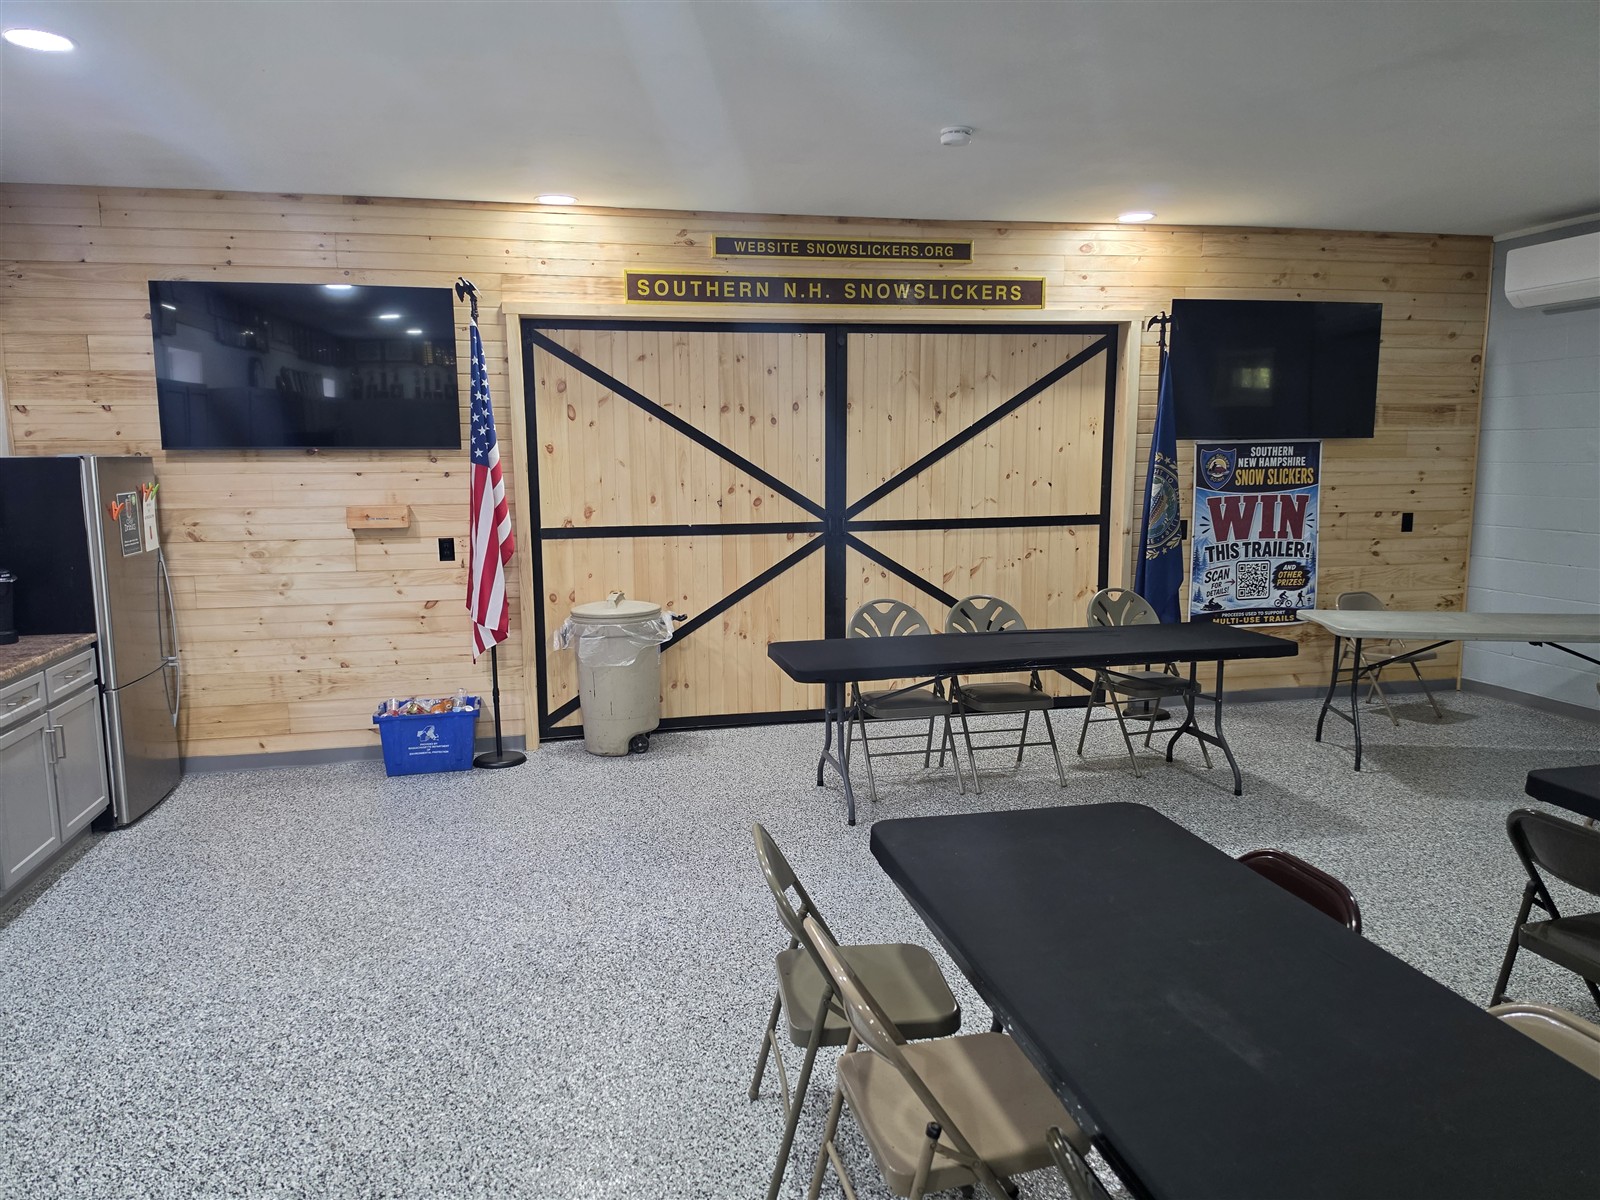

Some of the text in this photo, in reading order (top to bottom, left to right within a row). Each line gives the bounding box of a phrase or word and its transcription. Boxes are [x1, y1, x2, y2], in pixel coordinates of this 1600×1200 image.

[733, 240, 955, 258] WEBSITE SNOWSLICKERS.ORG
[636, 278, 1023, 302] SOUTHERN N.H. SNOWSLICKERS
[1250, 446, 1294, 457] SOUTHERN
[1238, 457, 1258, 468] NEW
[1258, 456, 1306, 467] HAMPSHIRE
[1235, 467, 1314, 486] SNOW SLICKERS
[1207, 493, 1310, 542] WIN
[1204, 541, 1312, 563] THIS TRAILER!
[1204, 568, 1231, 583] SCAN
[1277, 570, 1303, 579] OTHER
[1210, 581, 1223, 589] FOR
[1276, 578, 1306, 587] PRIZES!
[1206, 586, 1230, 598] DETAILS!
[1263, 614, 1295, 623] TRAILS
